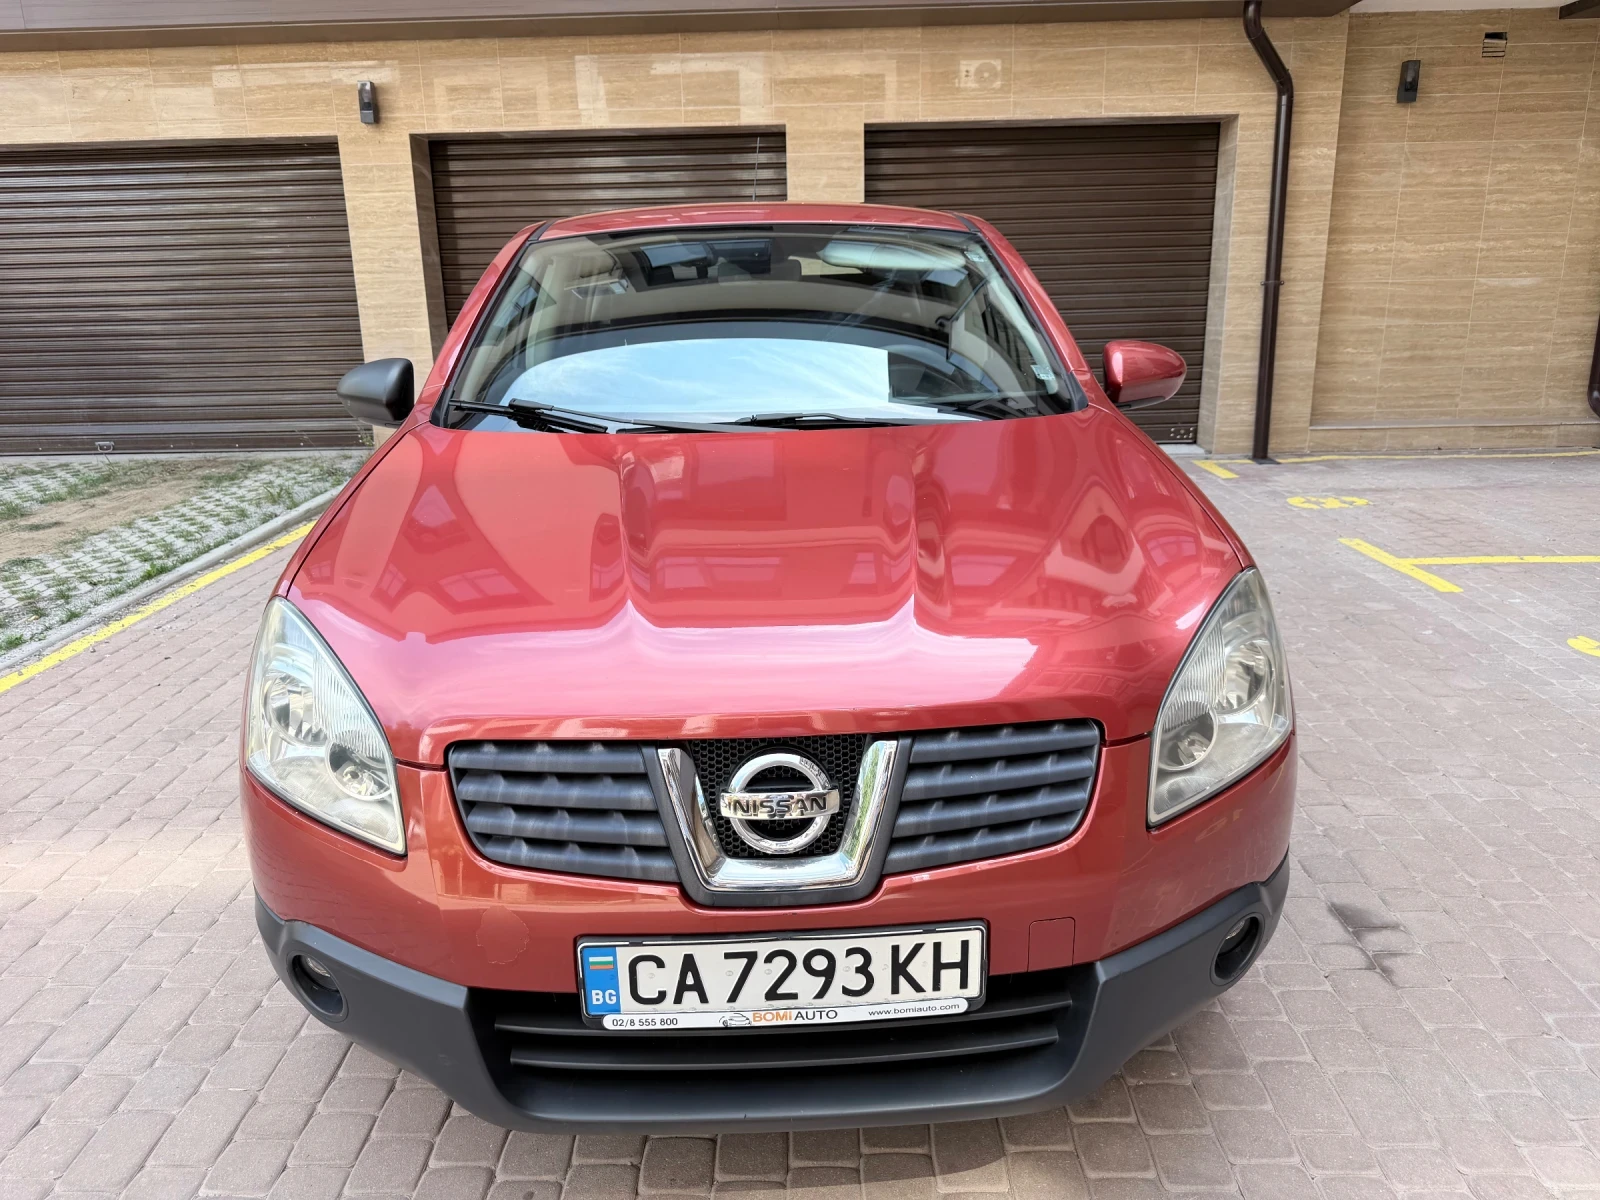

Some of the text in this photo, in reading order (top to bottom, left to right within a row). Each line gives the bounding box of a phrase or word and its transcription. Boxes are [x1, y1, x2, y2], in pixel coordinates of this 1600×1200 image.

[732, 796, 827, 814] NISSAN
[628, 939, 970, 1005] CA 7293 KH
[591, 989, 617, 1005] BG
[868, 1002, 960, 1016] www.bomiauto.com
[612, 1017, 678, 1028] 02/8 555 800
